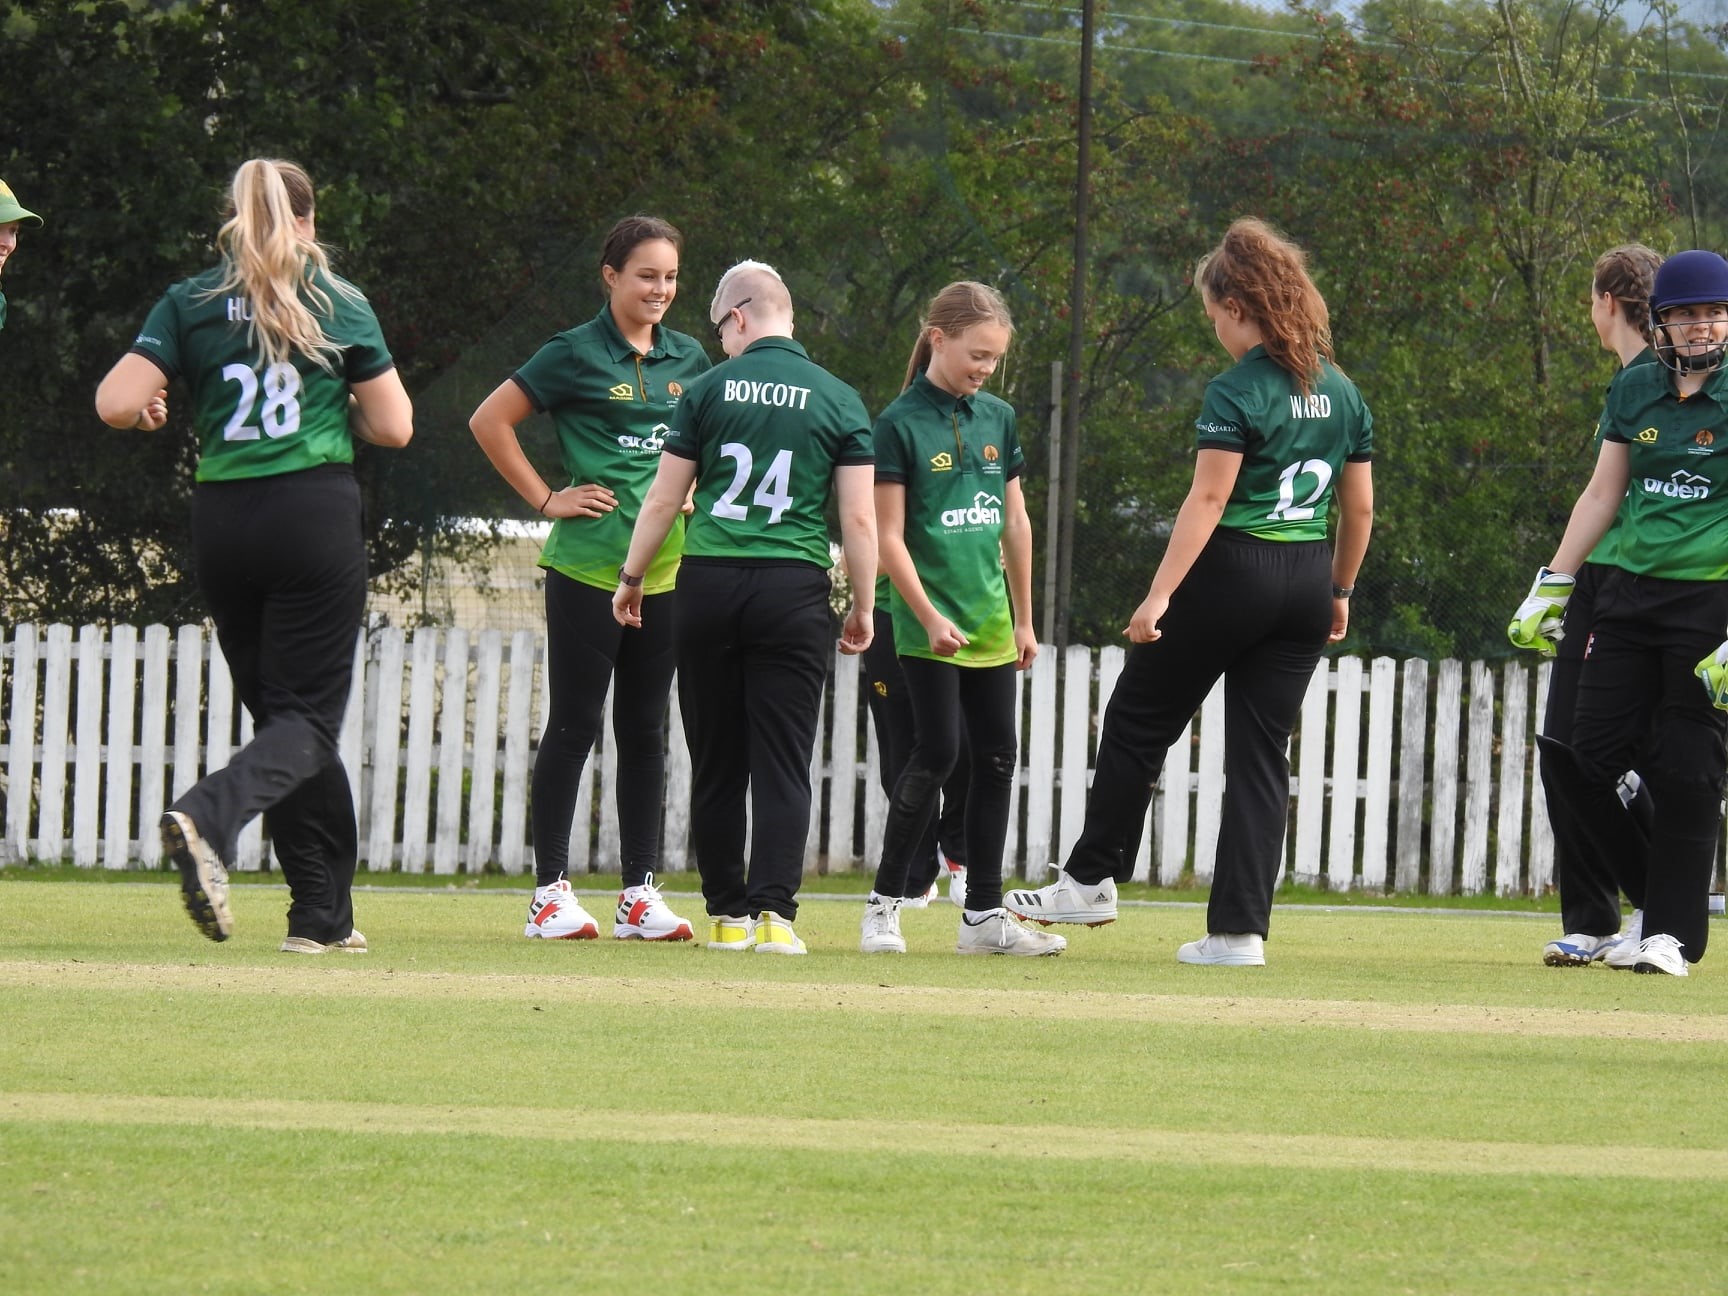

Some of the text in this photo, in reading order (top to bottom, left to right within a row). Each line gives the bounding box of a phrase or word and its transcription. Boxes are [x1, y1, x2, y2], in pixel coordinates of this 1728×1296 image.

[222, 363, 301, 442] 28
[724, 379, 811, 410] BOYCOTT
[1290, 394, 1332, 419] WARD
[617, 432, 665, 450] arde
[710, 442, 793, 524] 24
[1266, 458, 1333, 521] 12
[1643, 477, 1709, 499] arden
[941, 501, 1000, 527] arden
